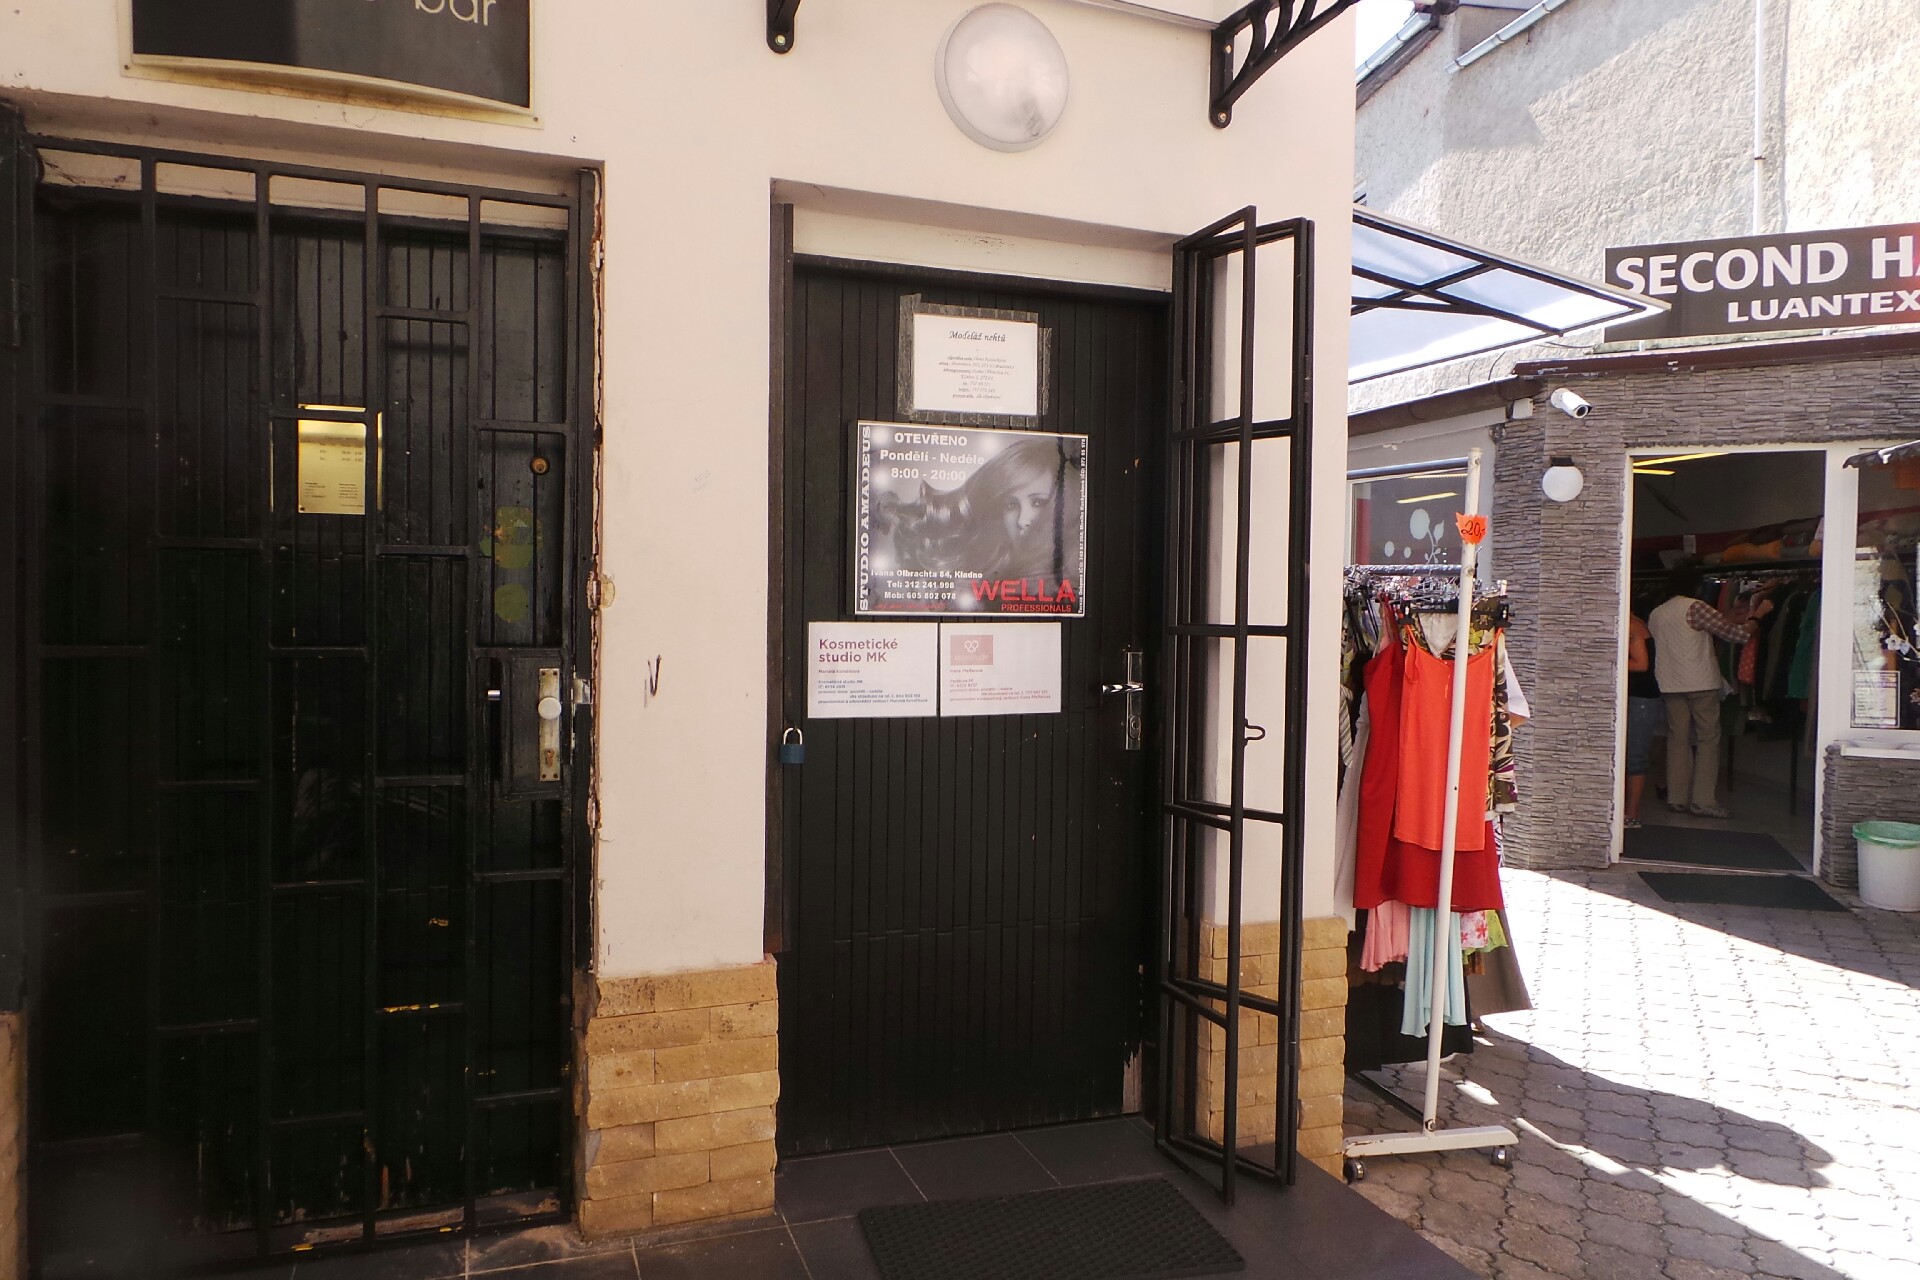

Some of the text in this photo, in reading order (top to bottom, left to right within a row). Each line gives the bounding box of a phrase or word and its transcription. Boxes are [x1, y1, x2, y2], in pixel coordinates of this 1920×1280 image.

[415, 0, 497, 26] ar
[1615, 240, 1849, 296] SECOND
[894, 431, 968, 447] OTEVŘENO
[880, 449, 929, 462] Pondělí
[939, 452, 985, 465] Neděle
[891, 467, 919, 479] 8:00
[931, 469, 966, 481] 20:00
[859, 426, 872, 611] STUDIO AMADEUS
[896, 569, 937, 578] Olbrachta
[954, 570, 983, 579] Kladno
[887, 580, 902, 588] Tel:
[904, 580, 920, 588] 312
[922, 581, 937, 589] 241
[971, 578, 1076, 603] WELLA
[884, 591, 904, 599] Mob:
[906, 591, 922, 600] 605
[923, 592, 940, 600] 802
[1001, 603, 1072, 613] PROFESSIONALS
[818, 637, 898, 650] Kosmetické
[818, 651, 887, 663] studio MK
